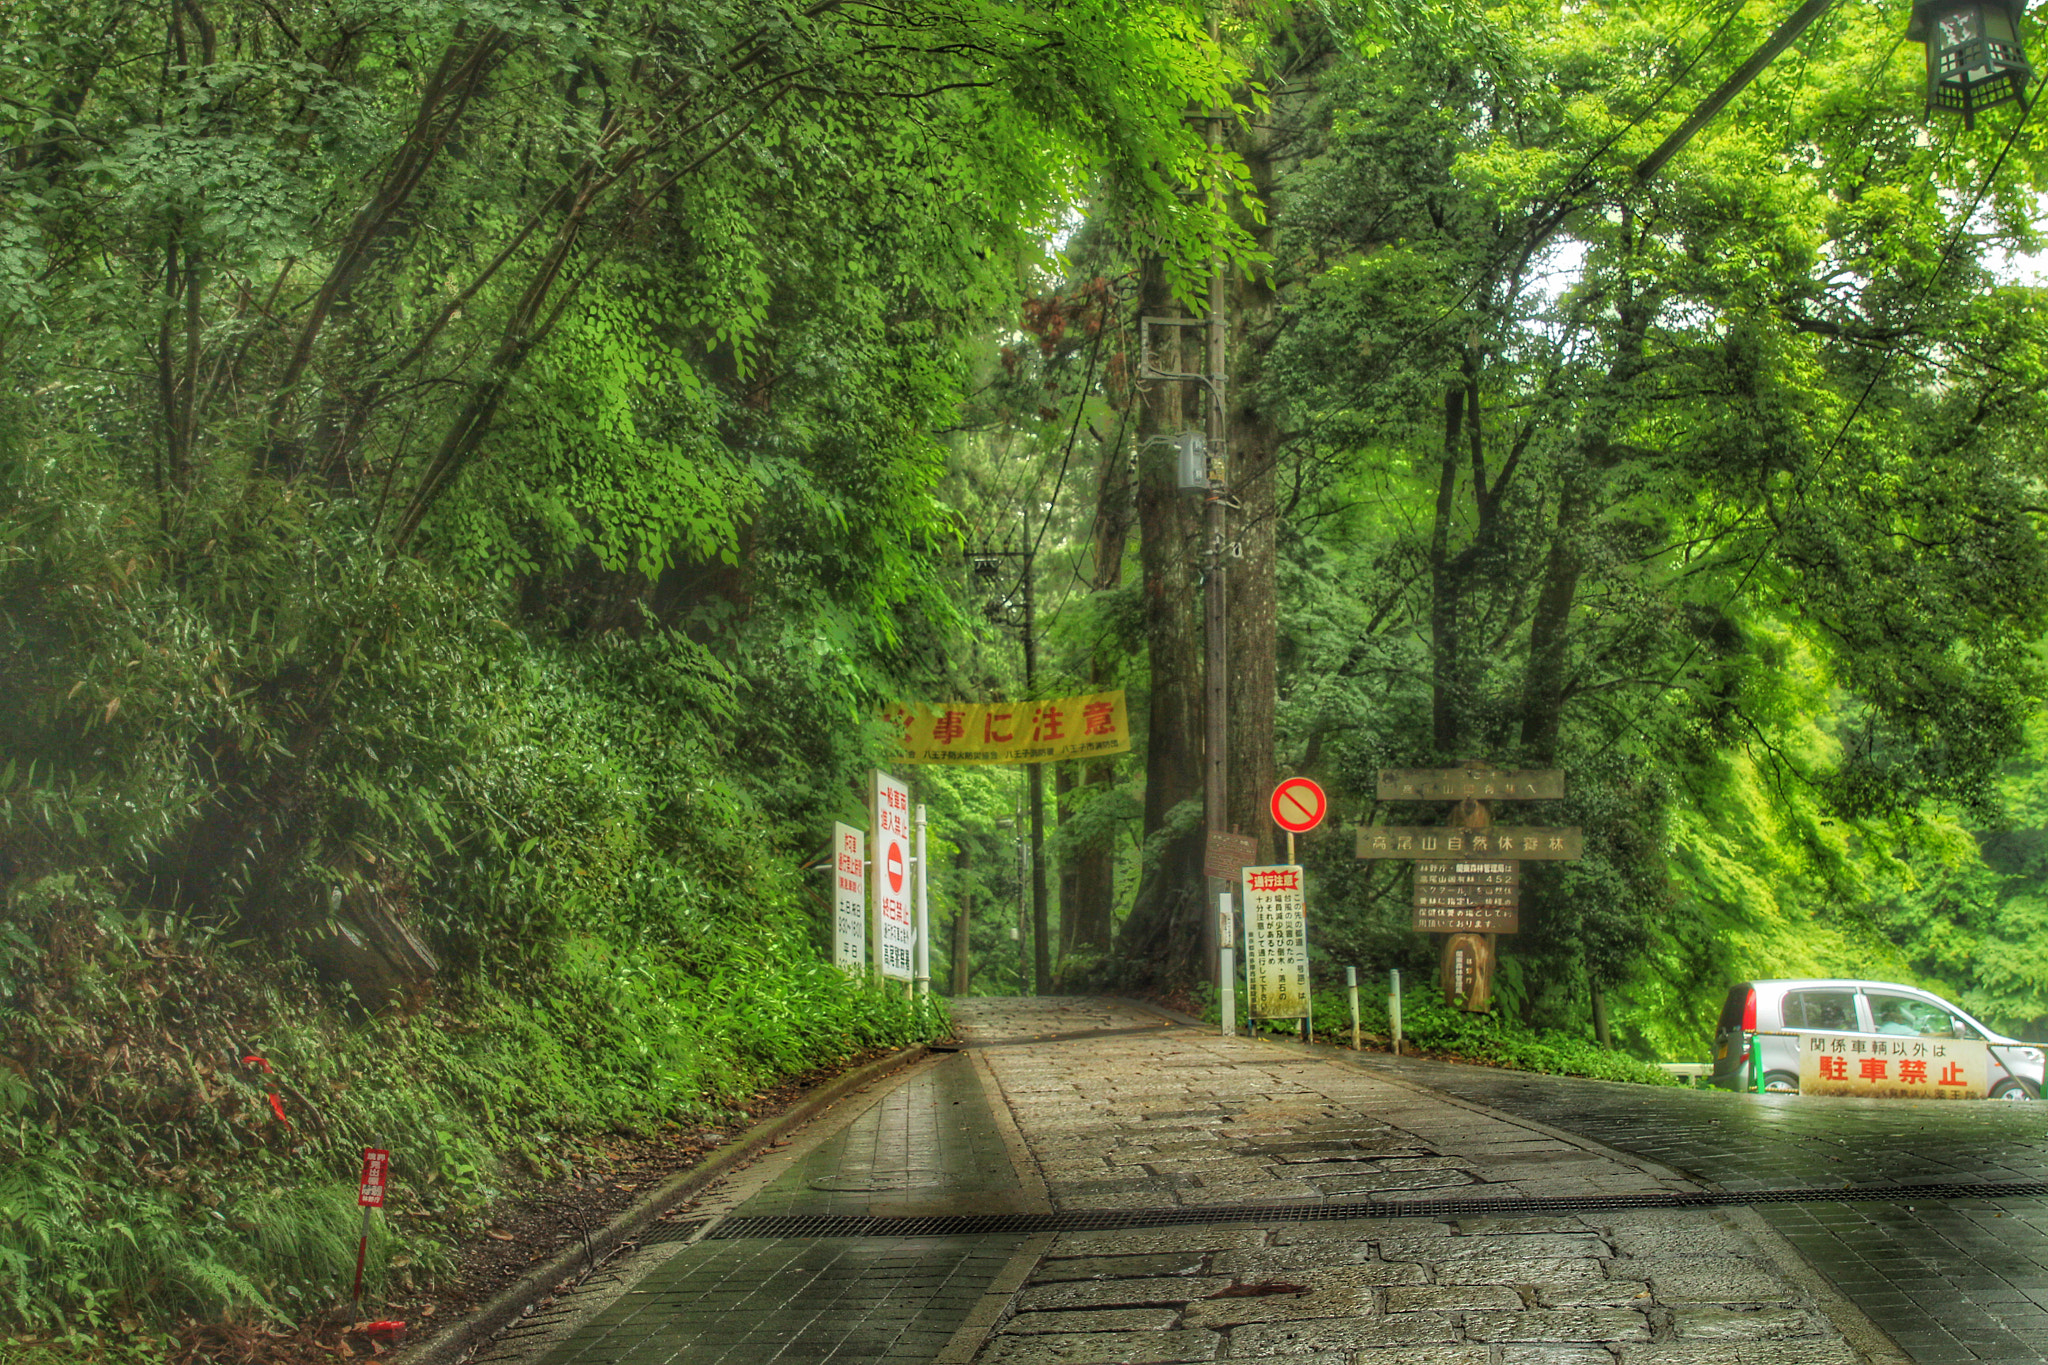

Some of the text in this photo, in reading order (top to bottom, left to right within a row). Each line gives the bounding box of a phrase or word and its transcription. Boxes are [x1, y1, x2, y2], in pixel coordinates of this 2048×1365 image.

[880, 786, 906, 814] 一般車両
[881, 808, 907, 840] 進入禁止
[1373, 836, 1564, 851] 高尾山自然休養林
[1254, 875, 1294, 888] 通行注意
[882, 896, 909, 926] 終日禁止
[1265, 896, 1276, 965] おそれがあるため
[1284, 894, 1295, 965] 台風の災害のため
[884, 943, 910, 971] 高尾警察署
[1819, 1056, 1968, 1087] 駐車禁止
